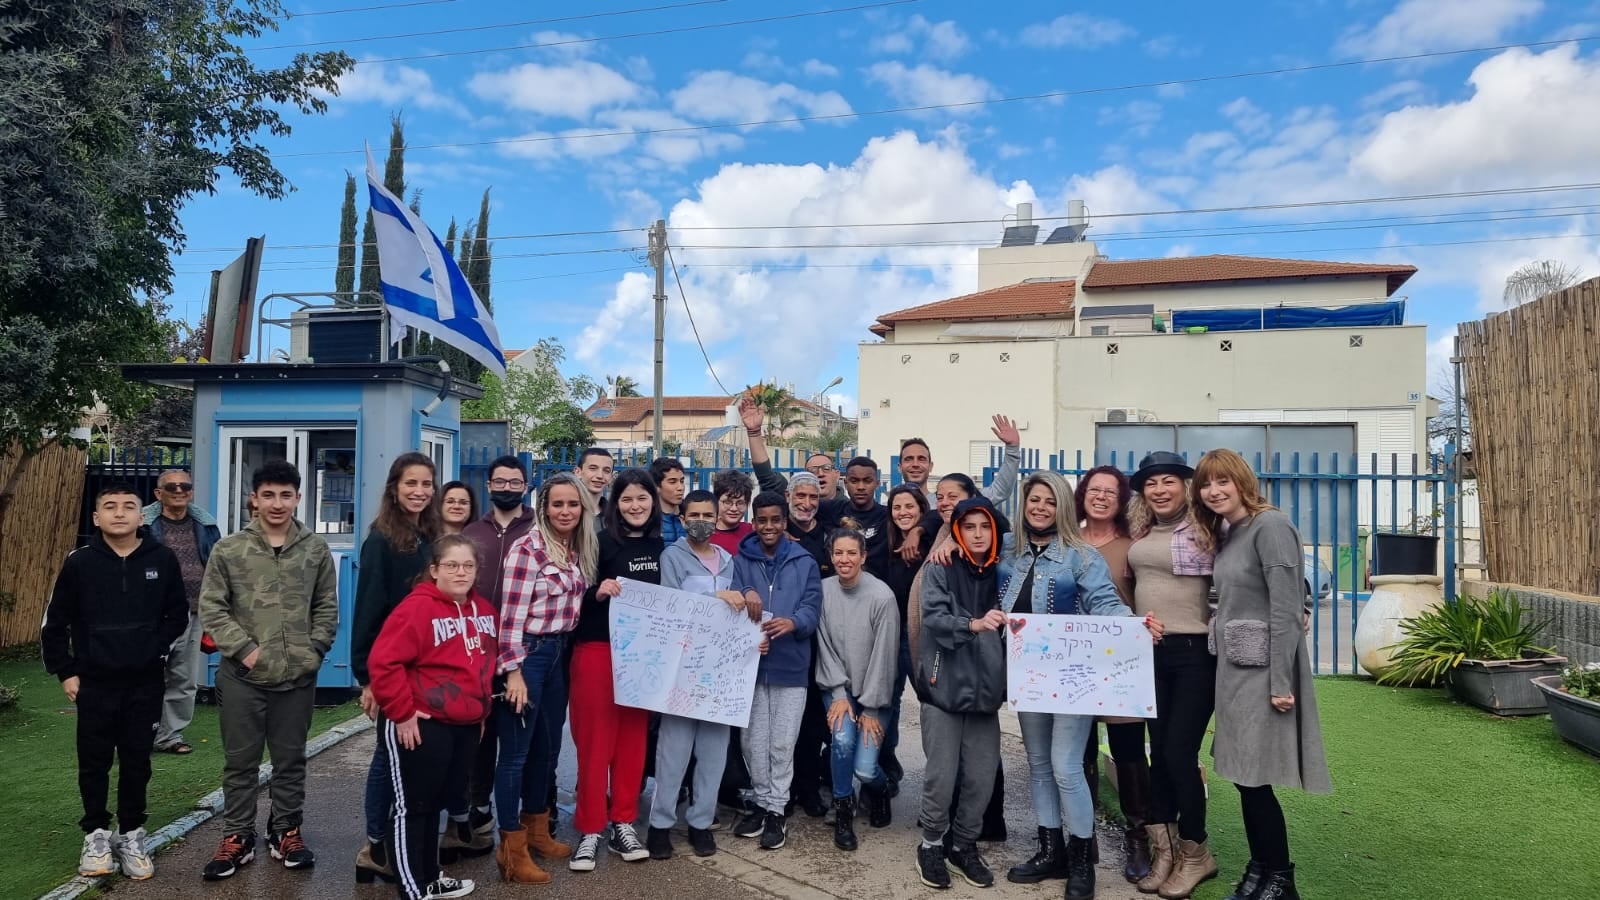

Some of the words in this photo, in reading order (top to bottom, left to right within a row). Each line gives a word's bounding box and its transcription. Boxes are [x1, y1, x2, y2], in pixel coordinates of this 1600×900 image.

[628, 562, 658, 572] boring
[432, 617, 466, 647] NEW
[1065, 620, 1123, 636] לאברהם
[1057, 637, 1093, 657] היקר
